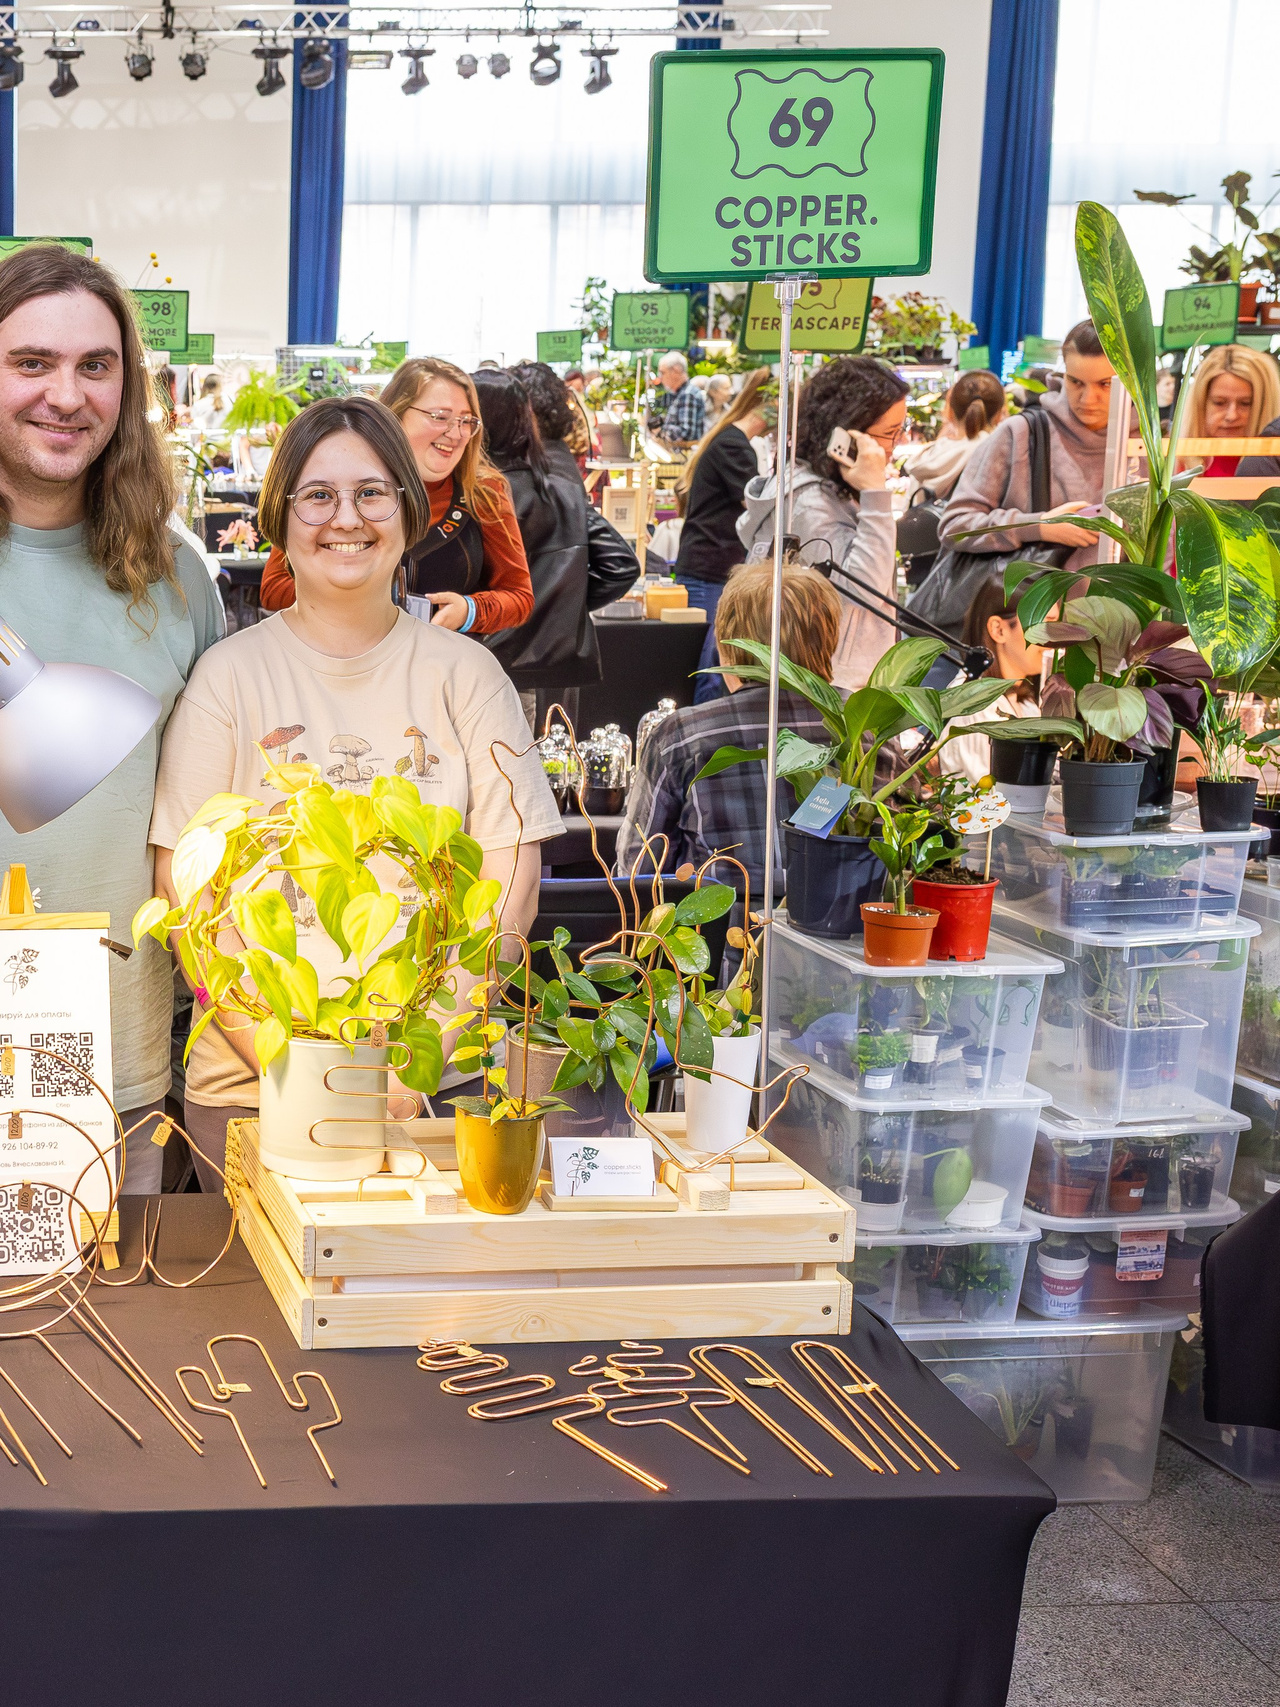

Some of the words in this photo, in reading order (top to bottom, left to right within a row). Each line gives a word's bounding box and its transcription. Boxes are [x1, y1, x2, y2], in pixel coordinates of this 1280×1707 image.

[768, 97, 834, 149] 69
[715, 193, 878, 229] COPPER.
[730, 231, 861, 267] STICKS
[641, 303, 659, 316] 95
[751, 316, 861, 331] TERASCAPE
[149, 328, 177, 337] MORE
[373, 1029, 383, 1047] 650
[10, 1118, 20, 1136] 1200
[153, 1126, 167, 1142] 1100
[1, 1142, 17, 1150] 926
[20, 1141, 59, 1150] 104-89-92
[12, 1160, 58, 1168] Вячеславовна
[21, 1191, 30, 1208] 1100
